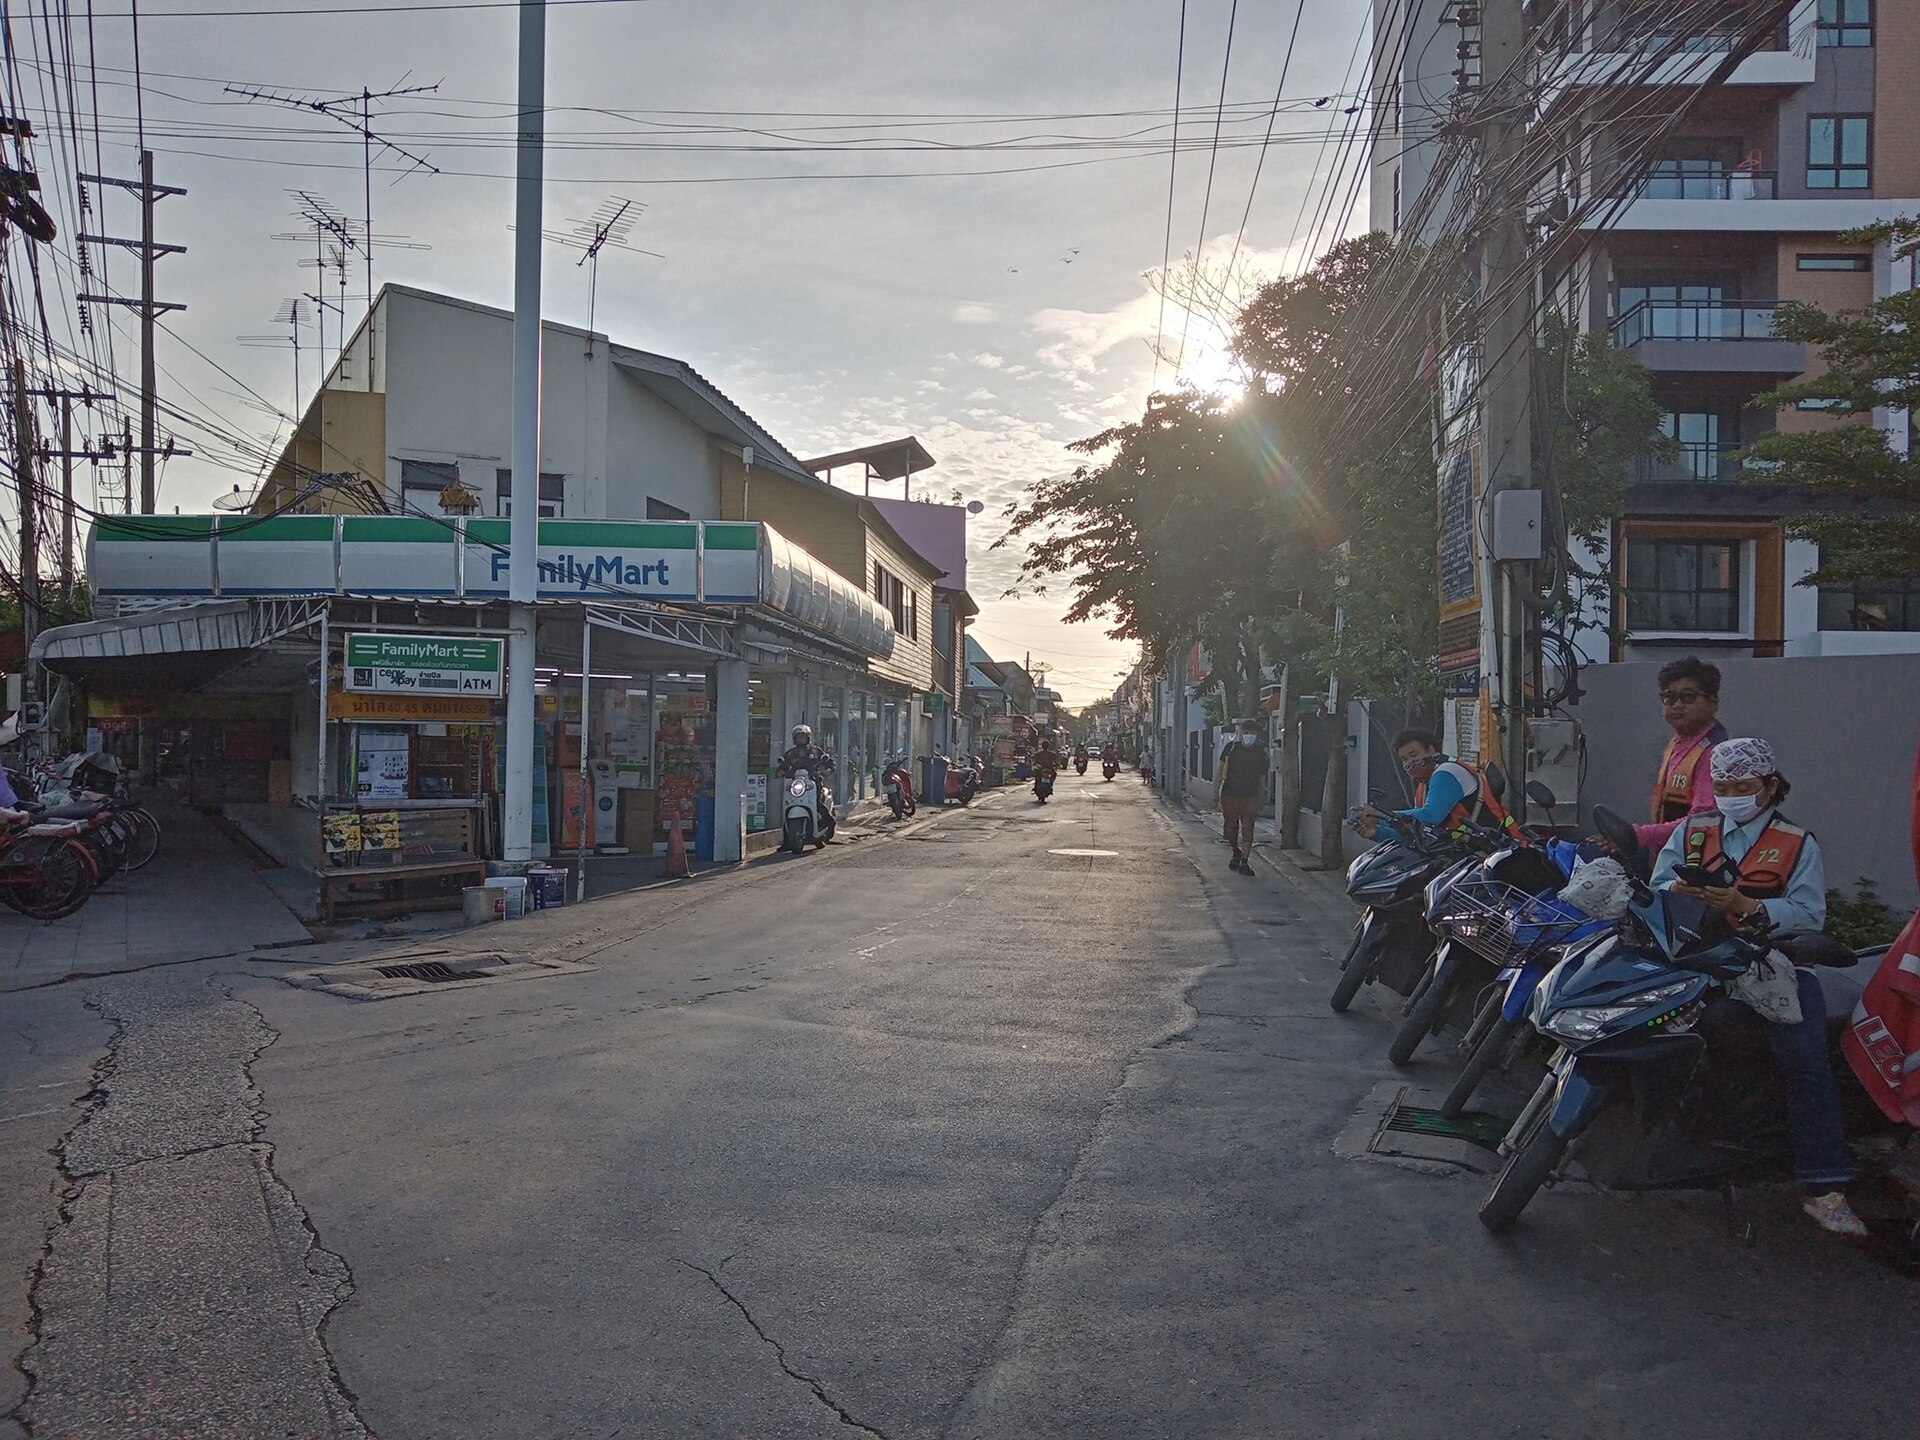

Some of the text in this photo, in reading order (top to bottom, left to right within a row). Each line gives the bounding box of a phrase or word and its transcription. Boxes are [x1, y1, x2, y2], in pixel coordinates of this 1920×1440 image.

[490, 553, 669, 590] FmilyMart
[381, 642, 459, 658] FamilyMart
[463, 678, 491, 690] ATM
[1672, 774, 1687, 788] 113
[1756, 848, 1780, 863] 72
